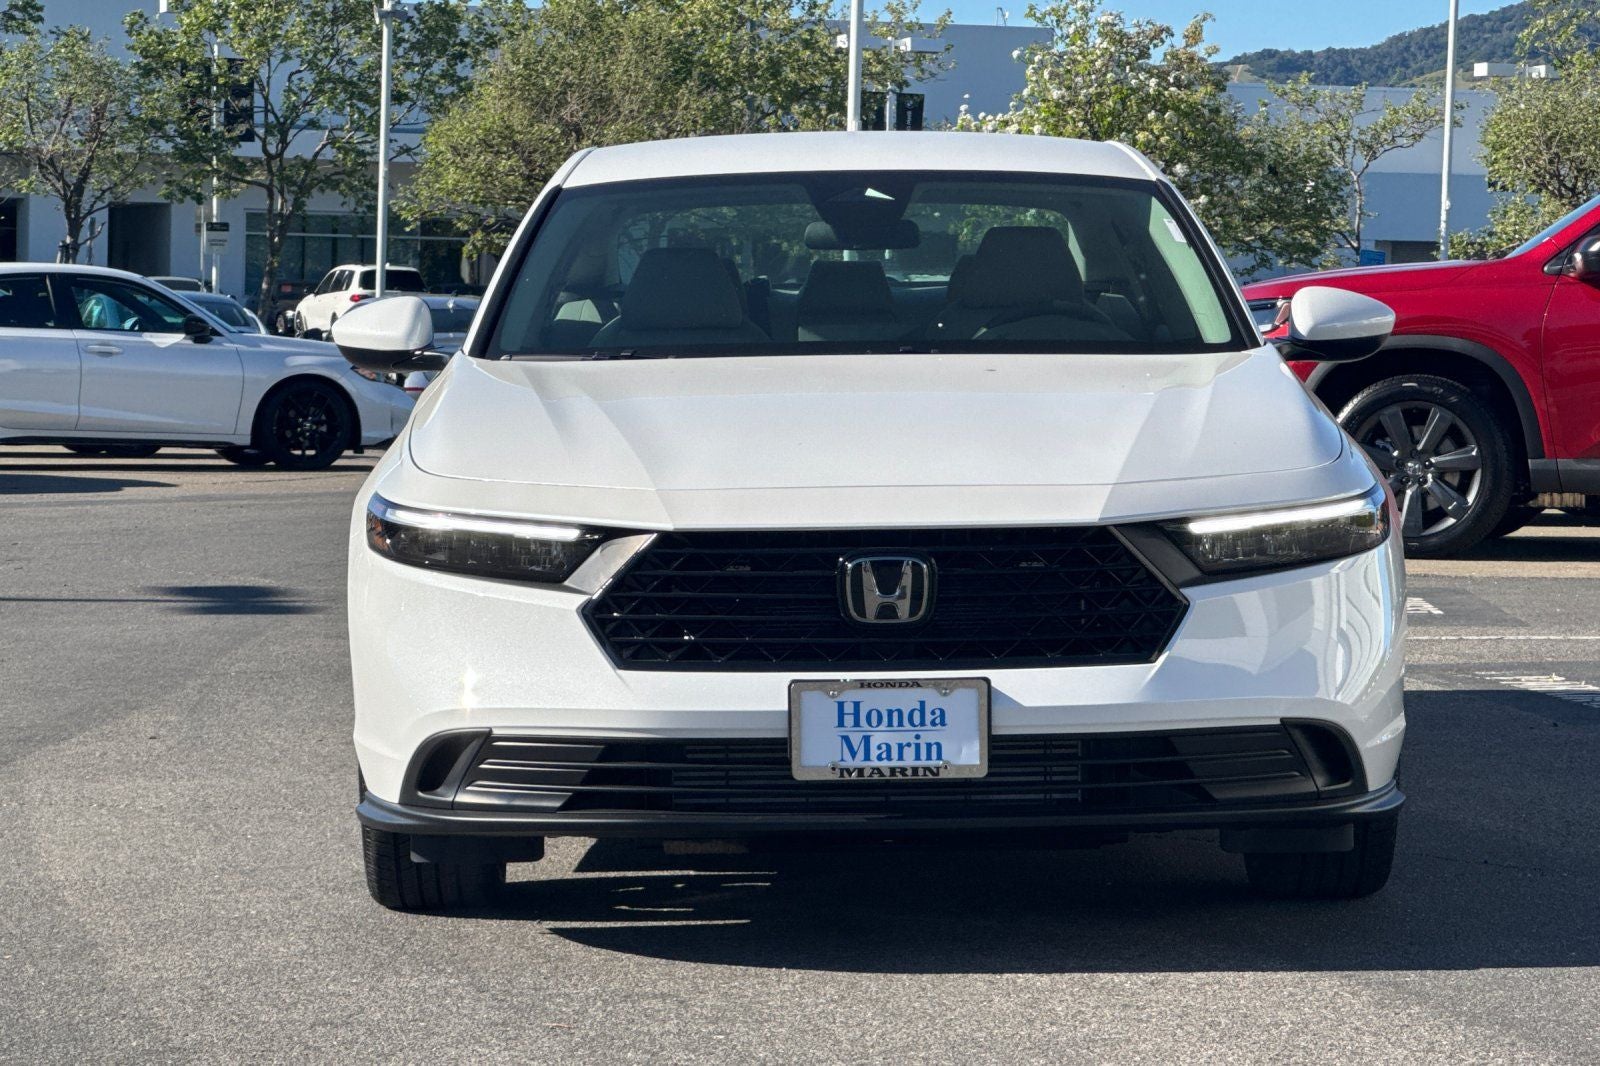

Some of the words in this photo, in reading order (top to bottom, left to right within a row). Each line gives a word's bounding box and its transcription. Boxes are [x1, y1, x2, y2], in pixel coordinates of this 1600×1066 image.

[859, 681, 923, 689] HONDA
[834, 700, 948, 729] Honda
[838, 733, 943, 763] Marin
[838, 766, 942, 778] MARIN
